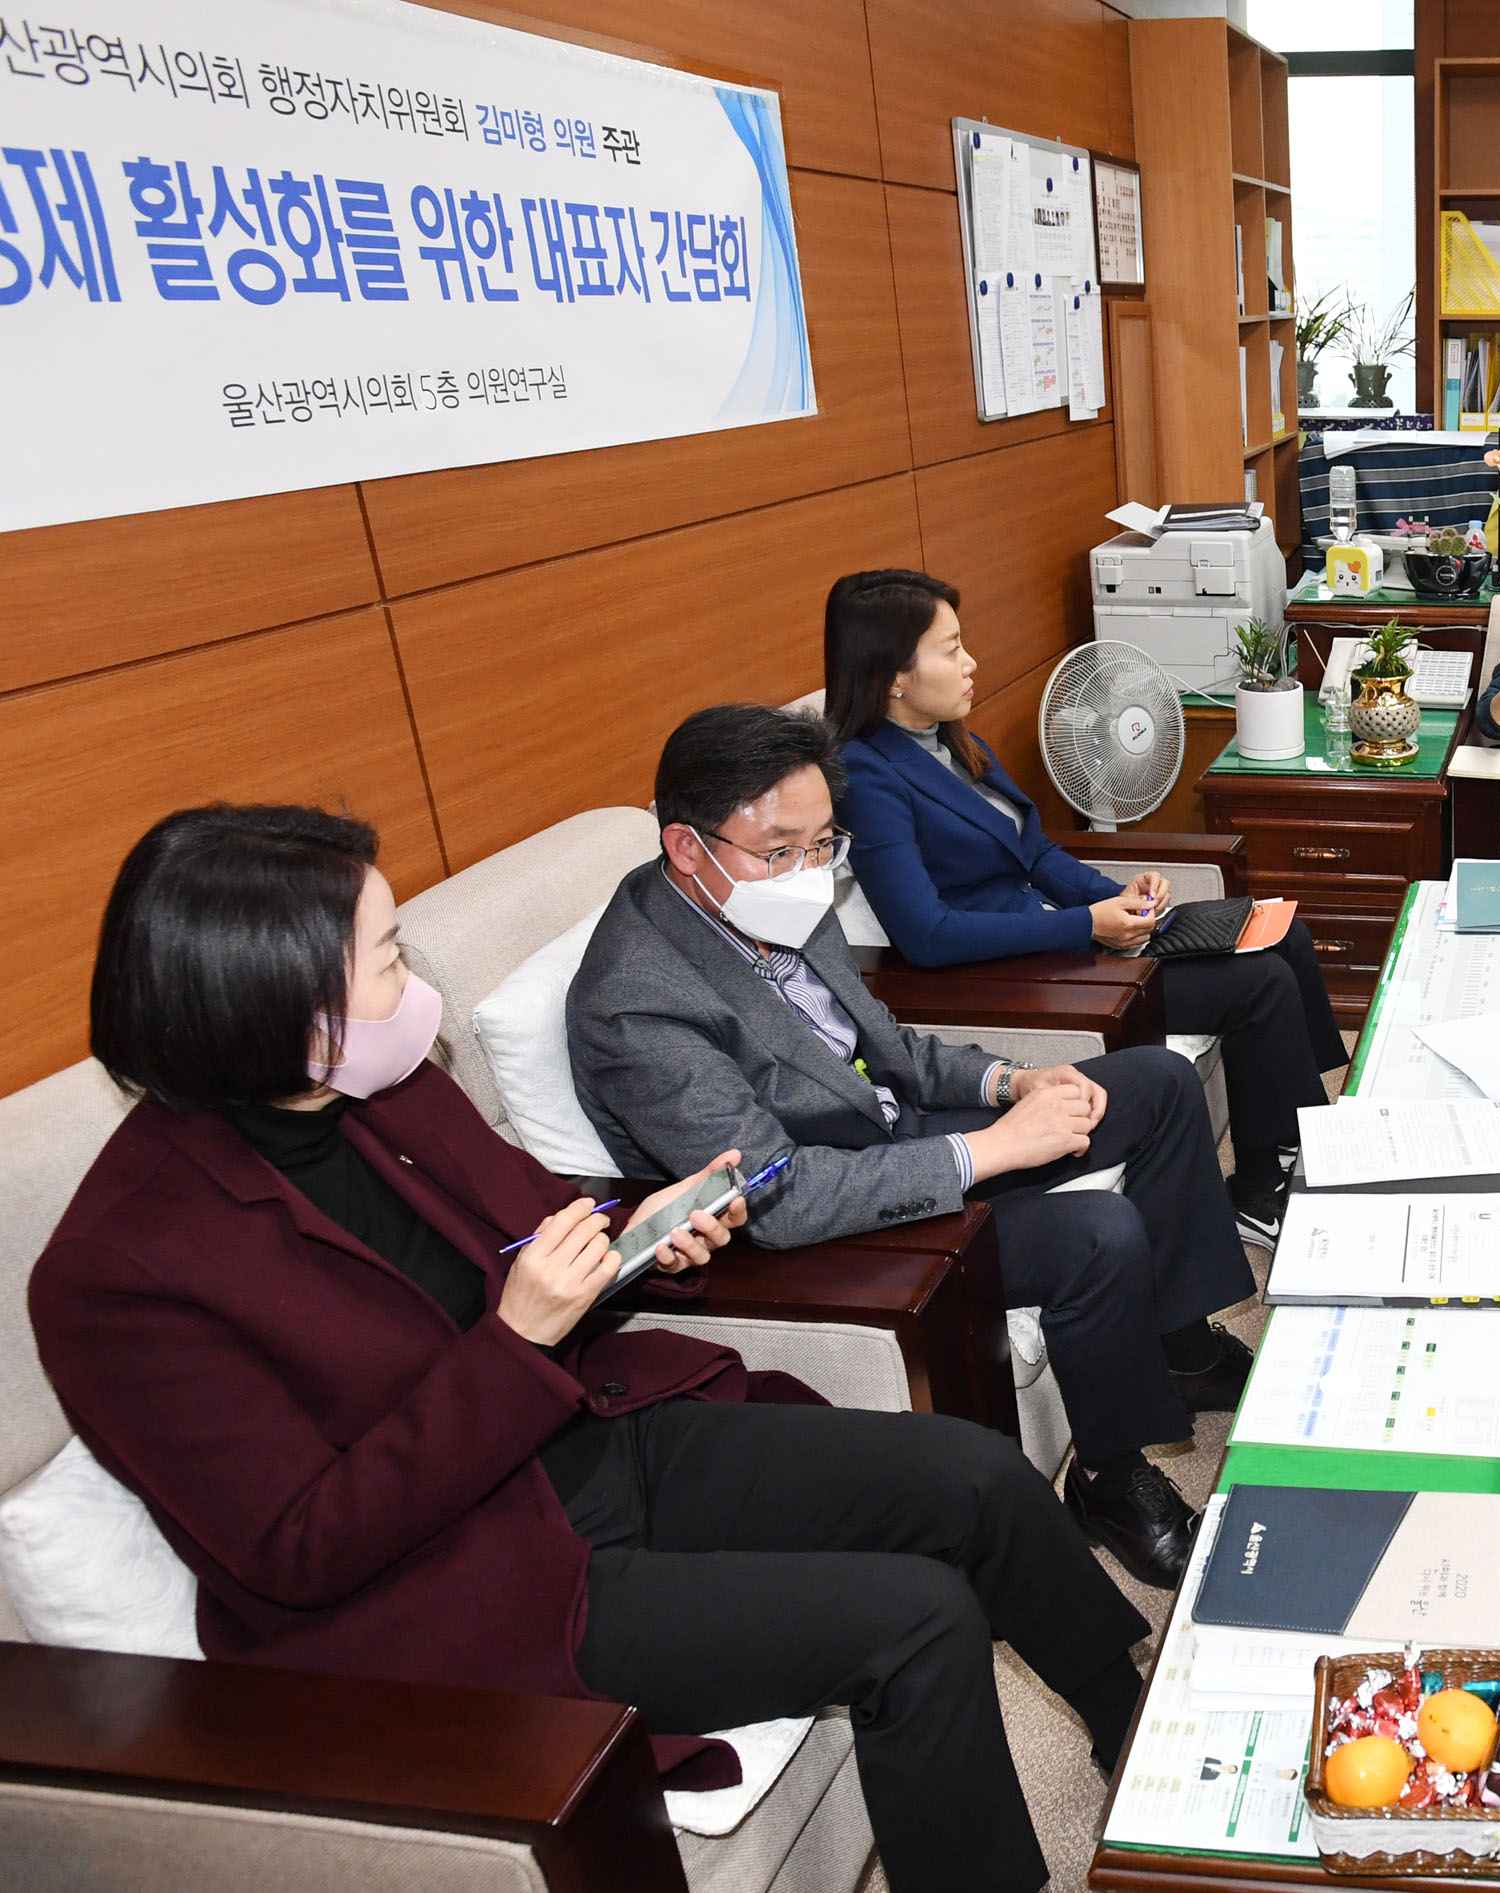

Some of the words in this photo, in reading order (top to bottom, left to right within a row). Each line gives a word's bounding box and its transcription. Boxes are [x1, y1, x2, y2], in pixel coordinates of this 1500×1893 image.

[0, 17, 249, 108] 산광역시의회
[258, 63, 469, 141] 행정자치위원회
[475, 104, 547, 152] 김미형
[554, 118, 597, 159] 의원
[601, 125, 641, 165] 주관
[121, 156, 409, 305] 활성화를
[410, 184, 519, 303] 위한
[520, 197, 651, 303] 대표자
[650, 210, 751, 303] 간담회
[222, 373, 417, 428] 울산광역시의회
[420, 370, 460, 410] 5층
[467, 365, 567, 405] 의원연구실
[1241, 1533, 1264, 1575] 울산광역시
[1454, 1573, 1468, 1599] 2020
